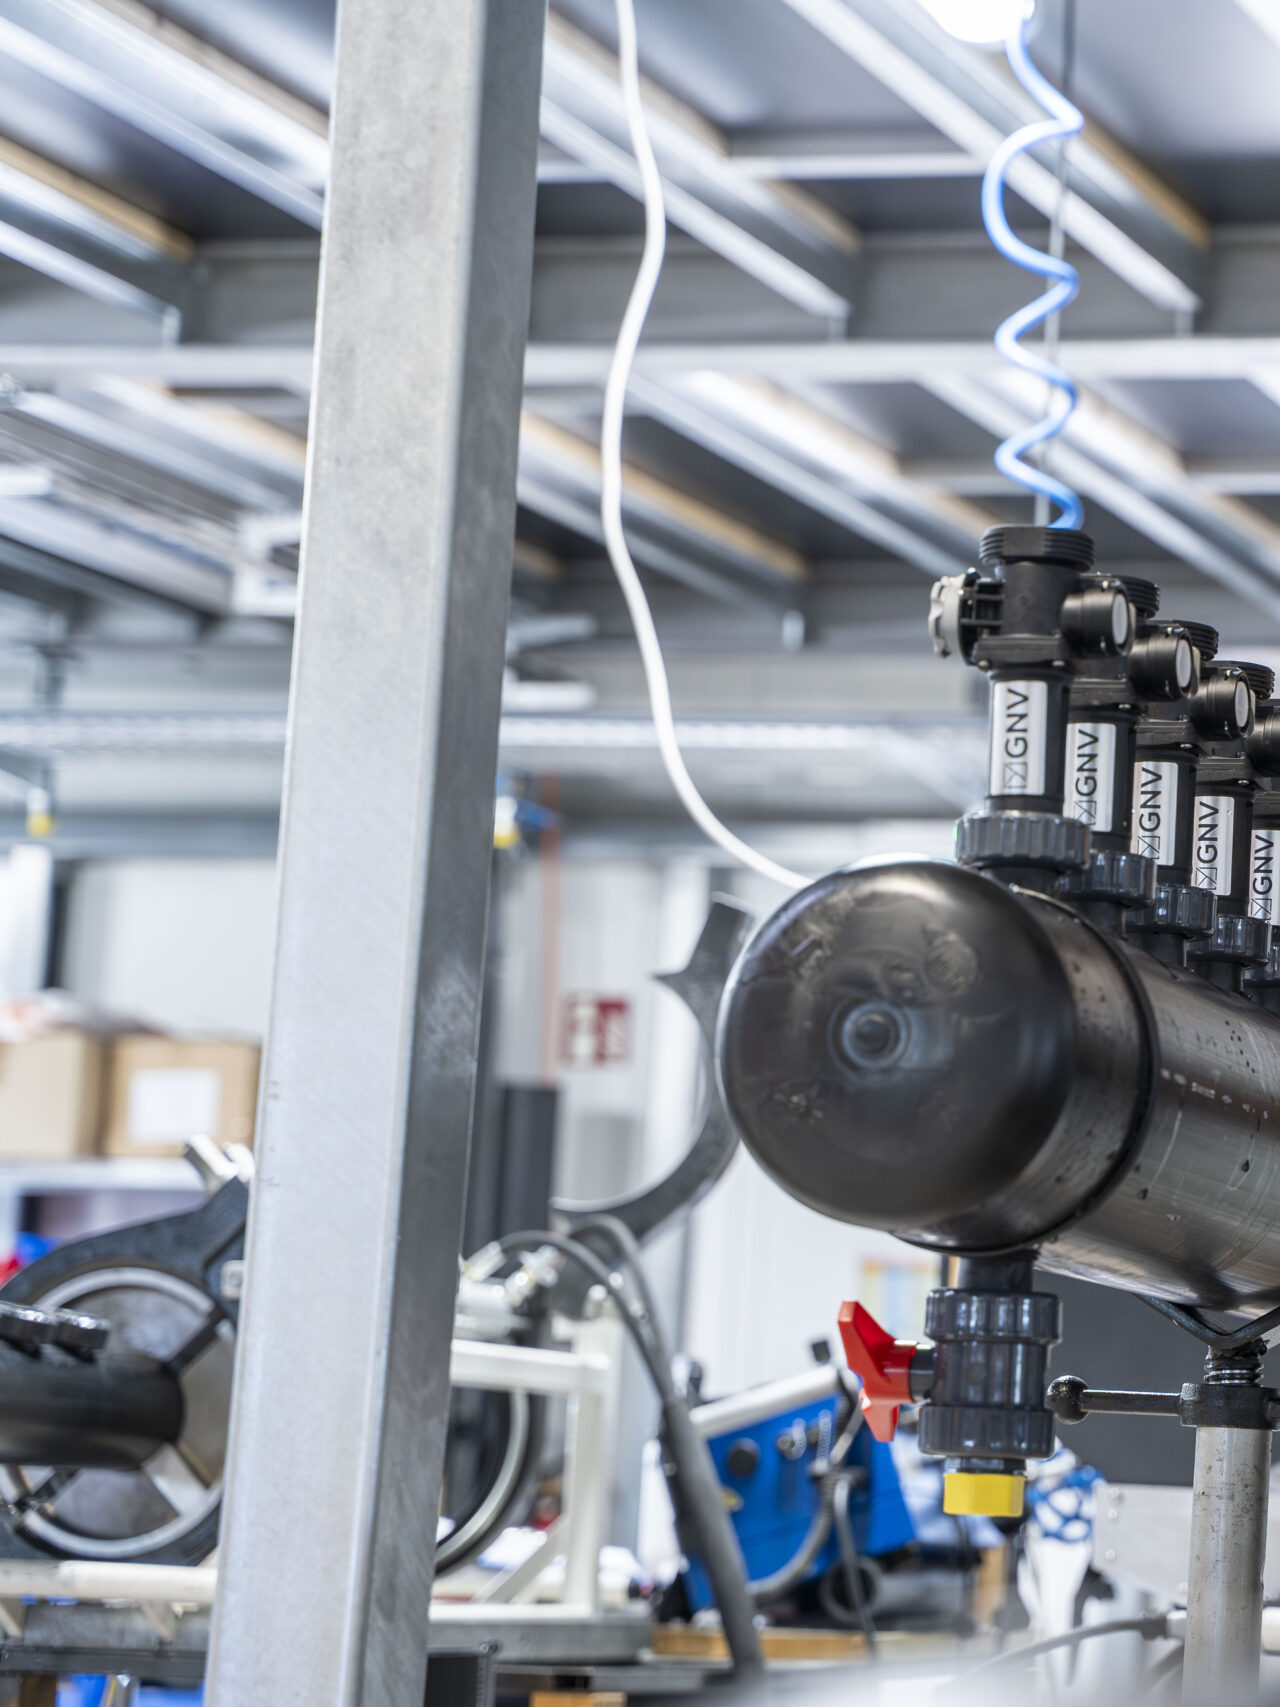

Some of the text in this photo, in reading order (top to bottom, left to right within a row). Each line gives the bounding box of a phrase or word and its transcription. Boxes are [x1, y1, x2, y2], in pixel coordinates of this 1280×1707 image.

[1005, 688, 1029, 758] GNV
[1075, 729, 1099, 797] GNV
[1138, 767, 1162, 832] GNV
[1196, 801, 1219, 864] GNV
[1252, 834, 1274, 896] GNV
